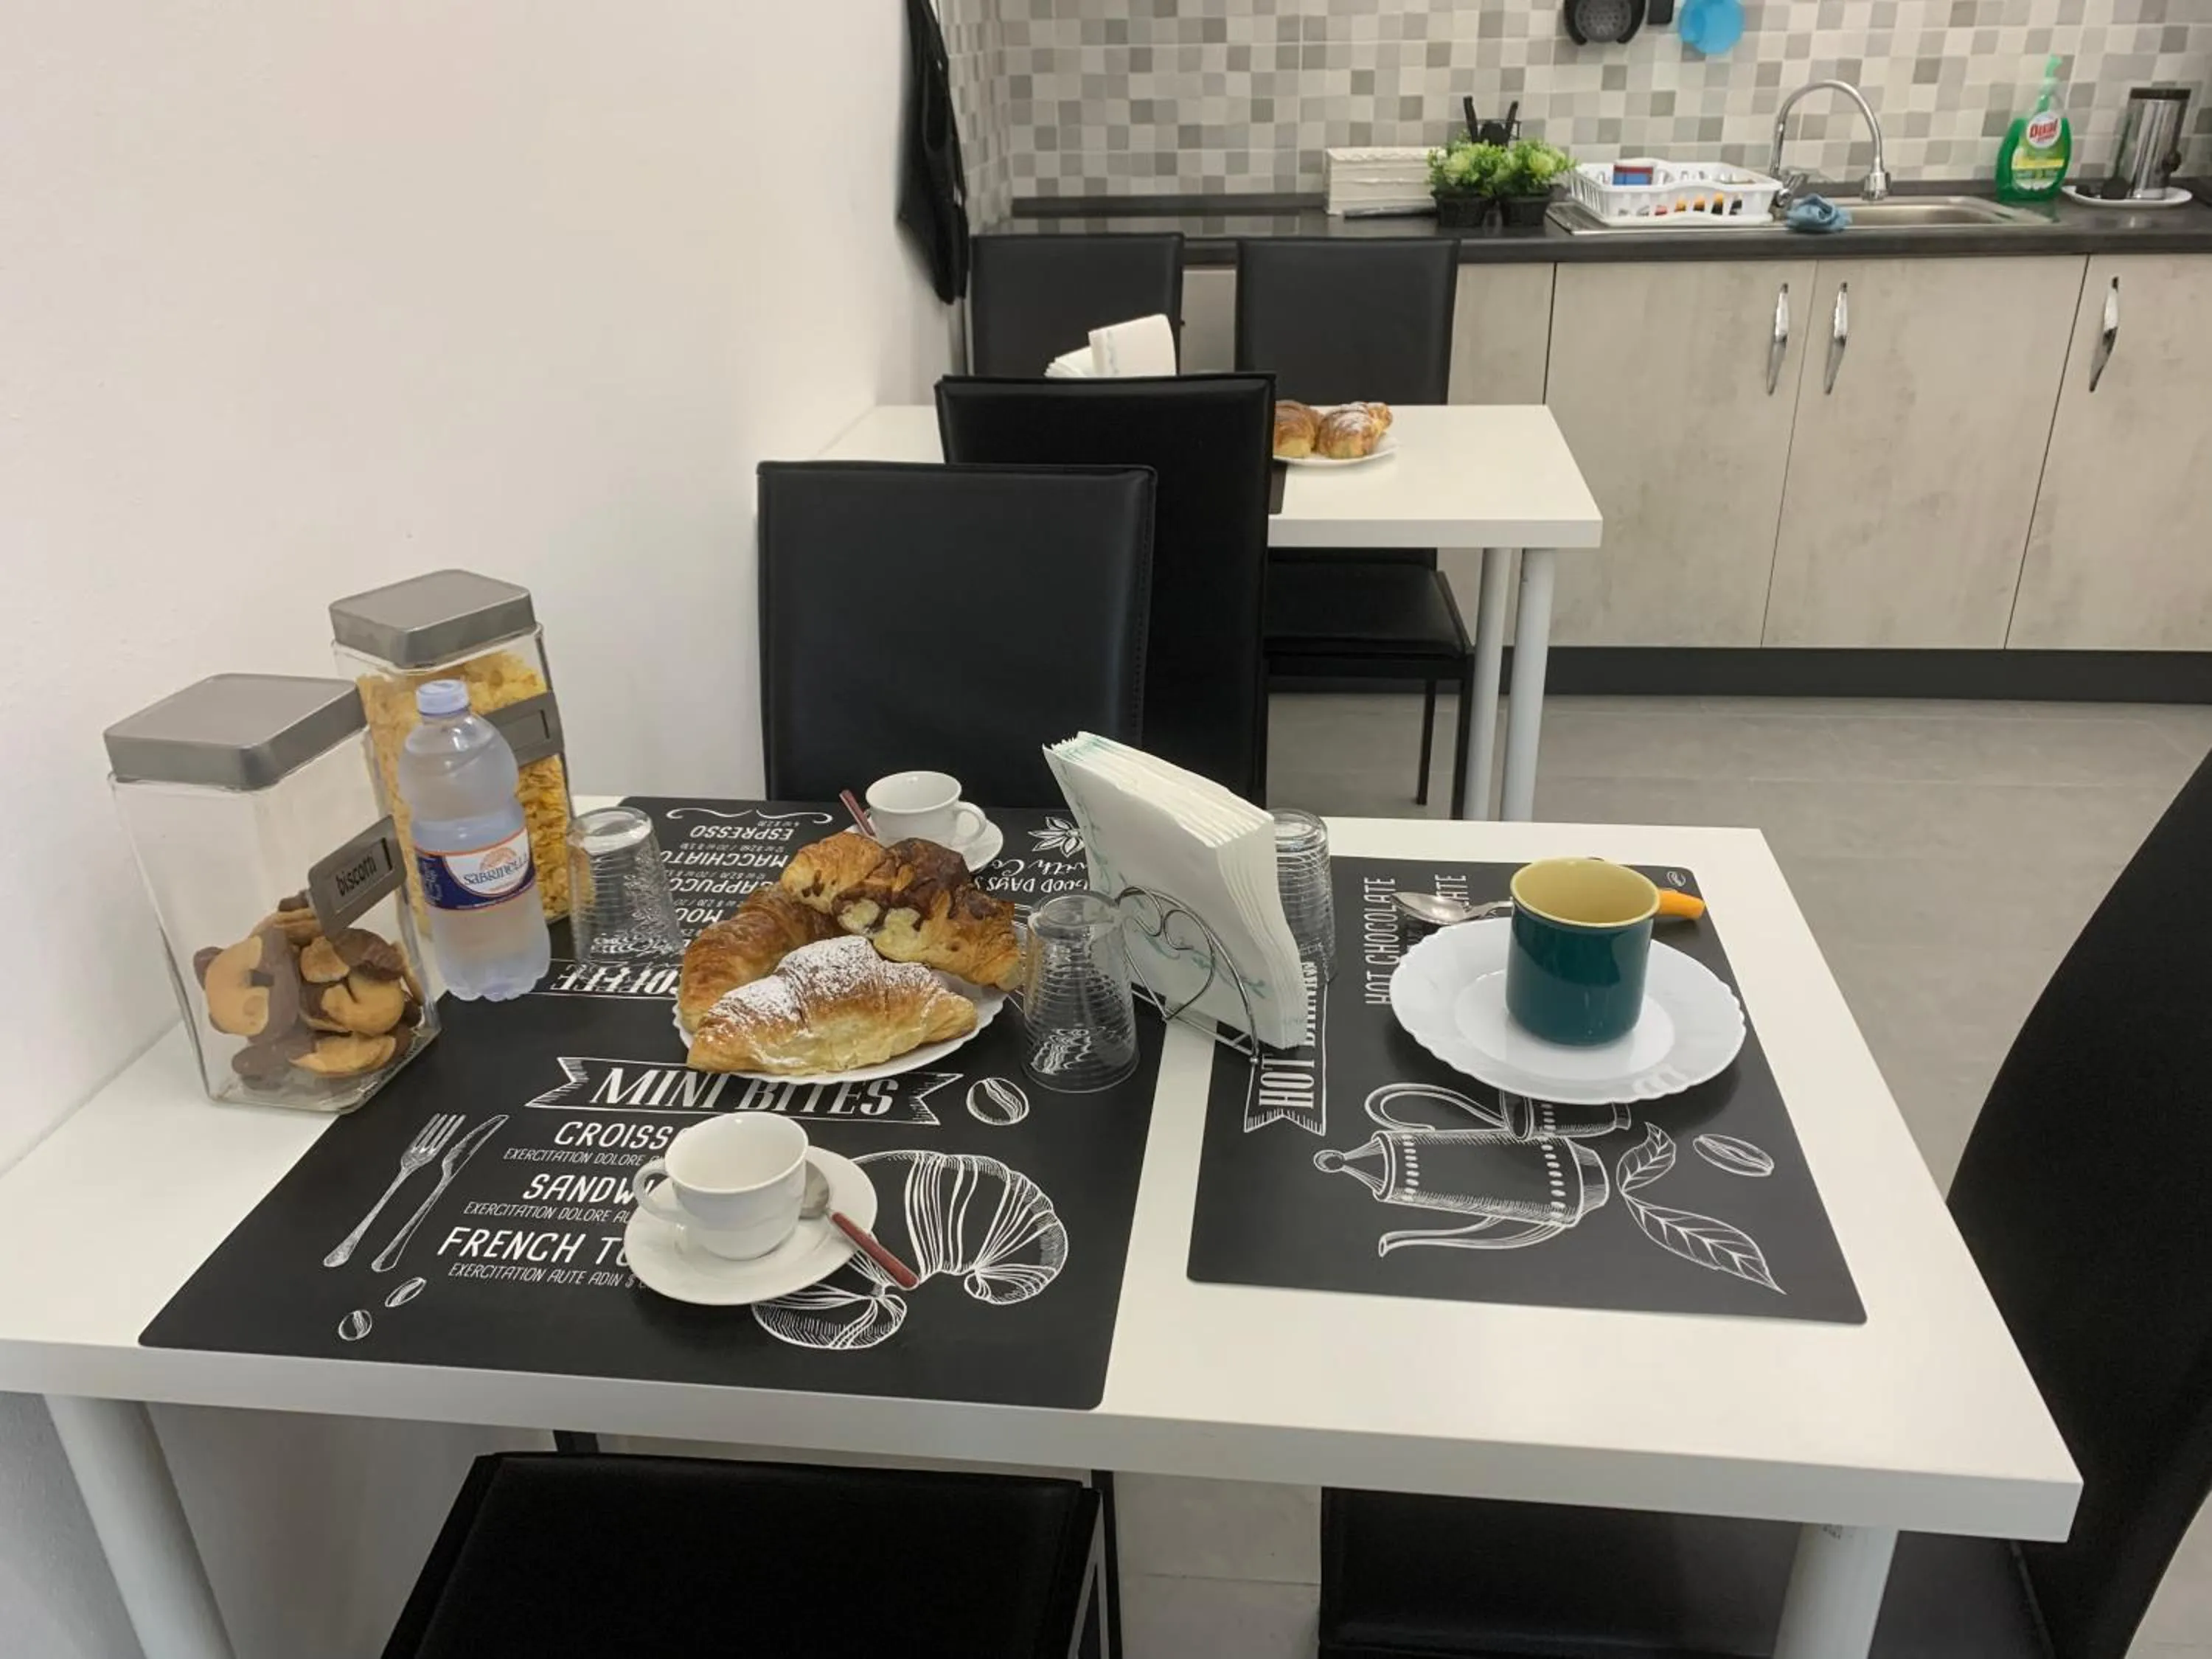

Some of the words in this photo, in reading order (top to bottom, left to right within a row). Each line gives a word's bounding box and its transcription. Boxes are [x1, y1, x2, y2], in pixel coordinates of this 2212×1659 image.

[689, 825, 794, 841] ESPRESSO
[669, 878, 773, 894] APPUCC
[987, 877, 1036, 892] DAYS
[1434, 874, 1470, 905] ATE
[675, 908, 724, 923] MOC
[1364, 877, 1400, 964] CHOCOLATE
[550, 964, 679, 995] OFFEE
[1365, 971, 1391, 1004] HOT
[589, 1067, 731, 1107] MINI
[734, 1077, 899, 1116] BITES
[1259, 1054, 1315, 1108] HOT
[554, 1121, 673, 1150] CROISS
[503, 1148, 594, 1164] EXERCITATION
[594, 1151, 644, 1166] DOLORE
[523, 1173, 655, 1205] SANDW
[464, 1201, 554, 1220] EXERCITATION
[558, 1206, 612, 1222] DOLORE
[437, 1226, 586, 1263] FRENCH
[448, 1262, 549, 1282] EXERCITATION
[549, 1267, 588, 1285] AUTE
[588, 1272, 625, 1287] ADIN
